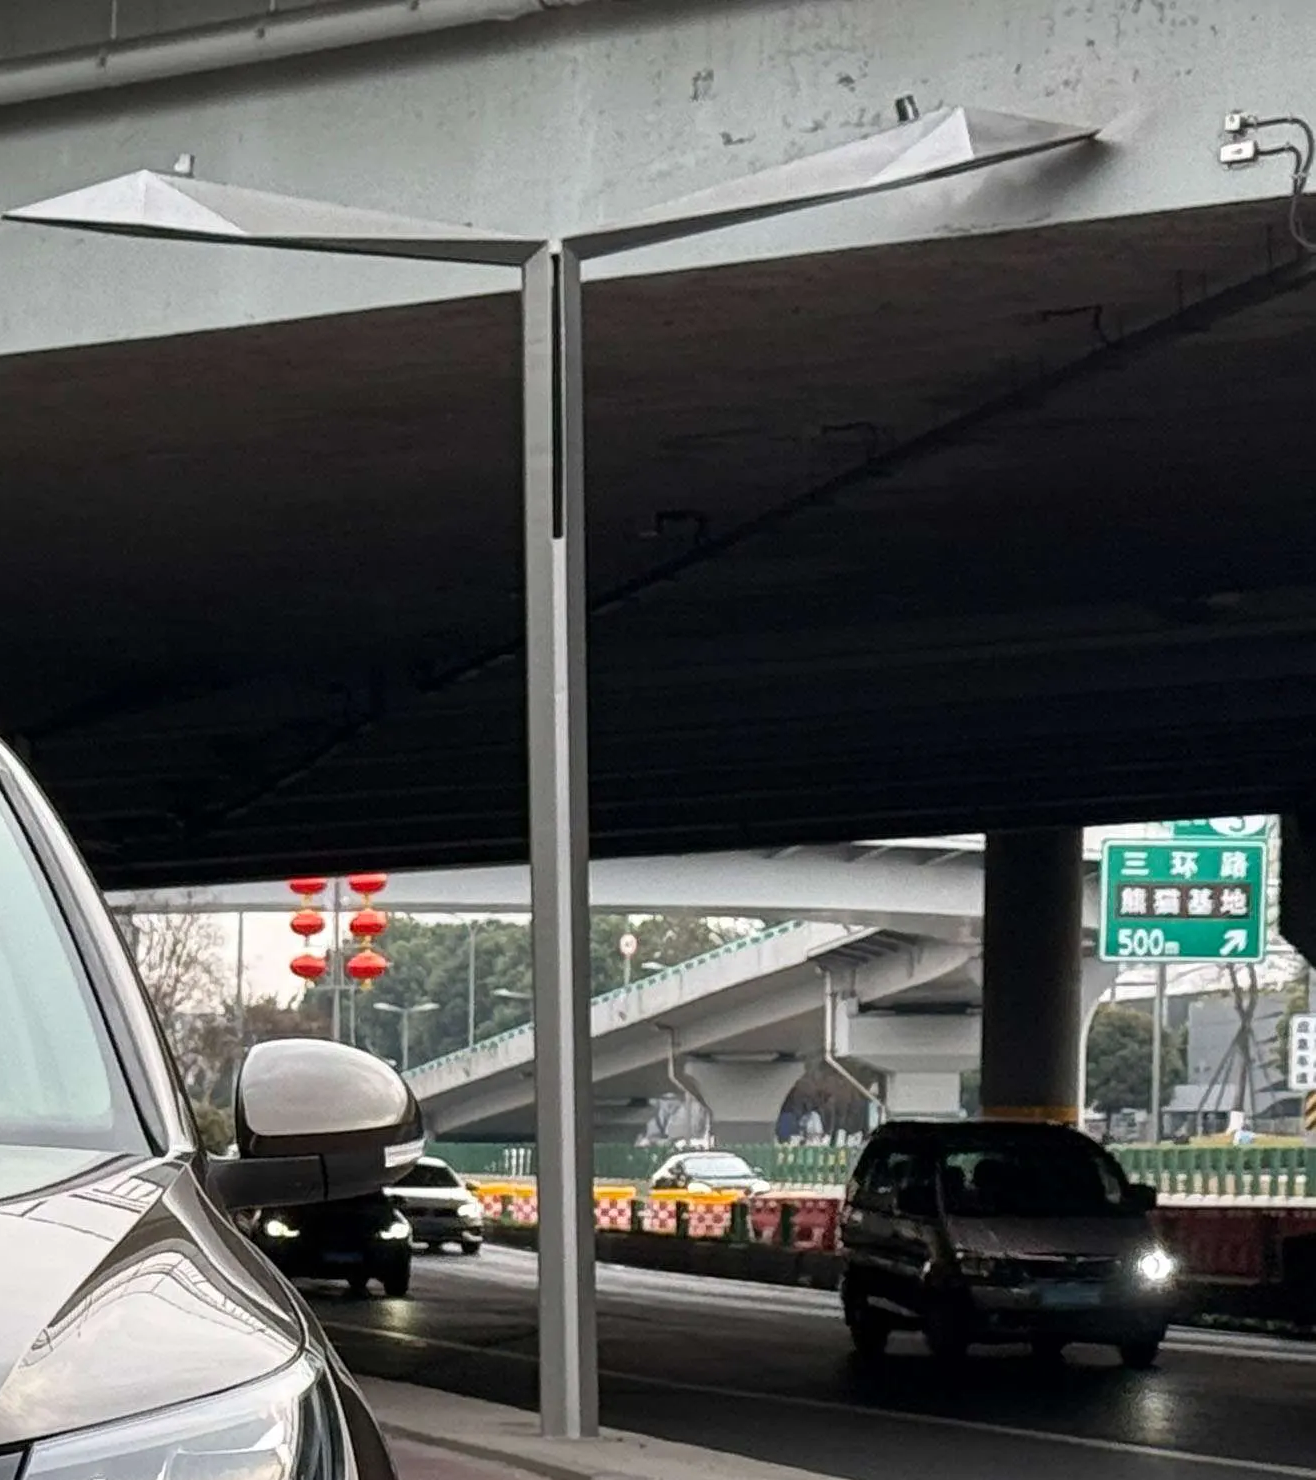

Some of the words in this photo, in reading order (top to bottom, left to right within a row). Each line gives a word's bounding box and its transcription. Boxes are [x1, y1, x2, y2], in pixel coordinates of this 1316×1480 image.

[1121, 851, 1248, 879] 三环路
[1118, 928, 1180, 955] 500m
